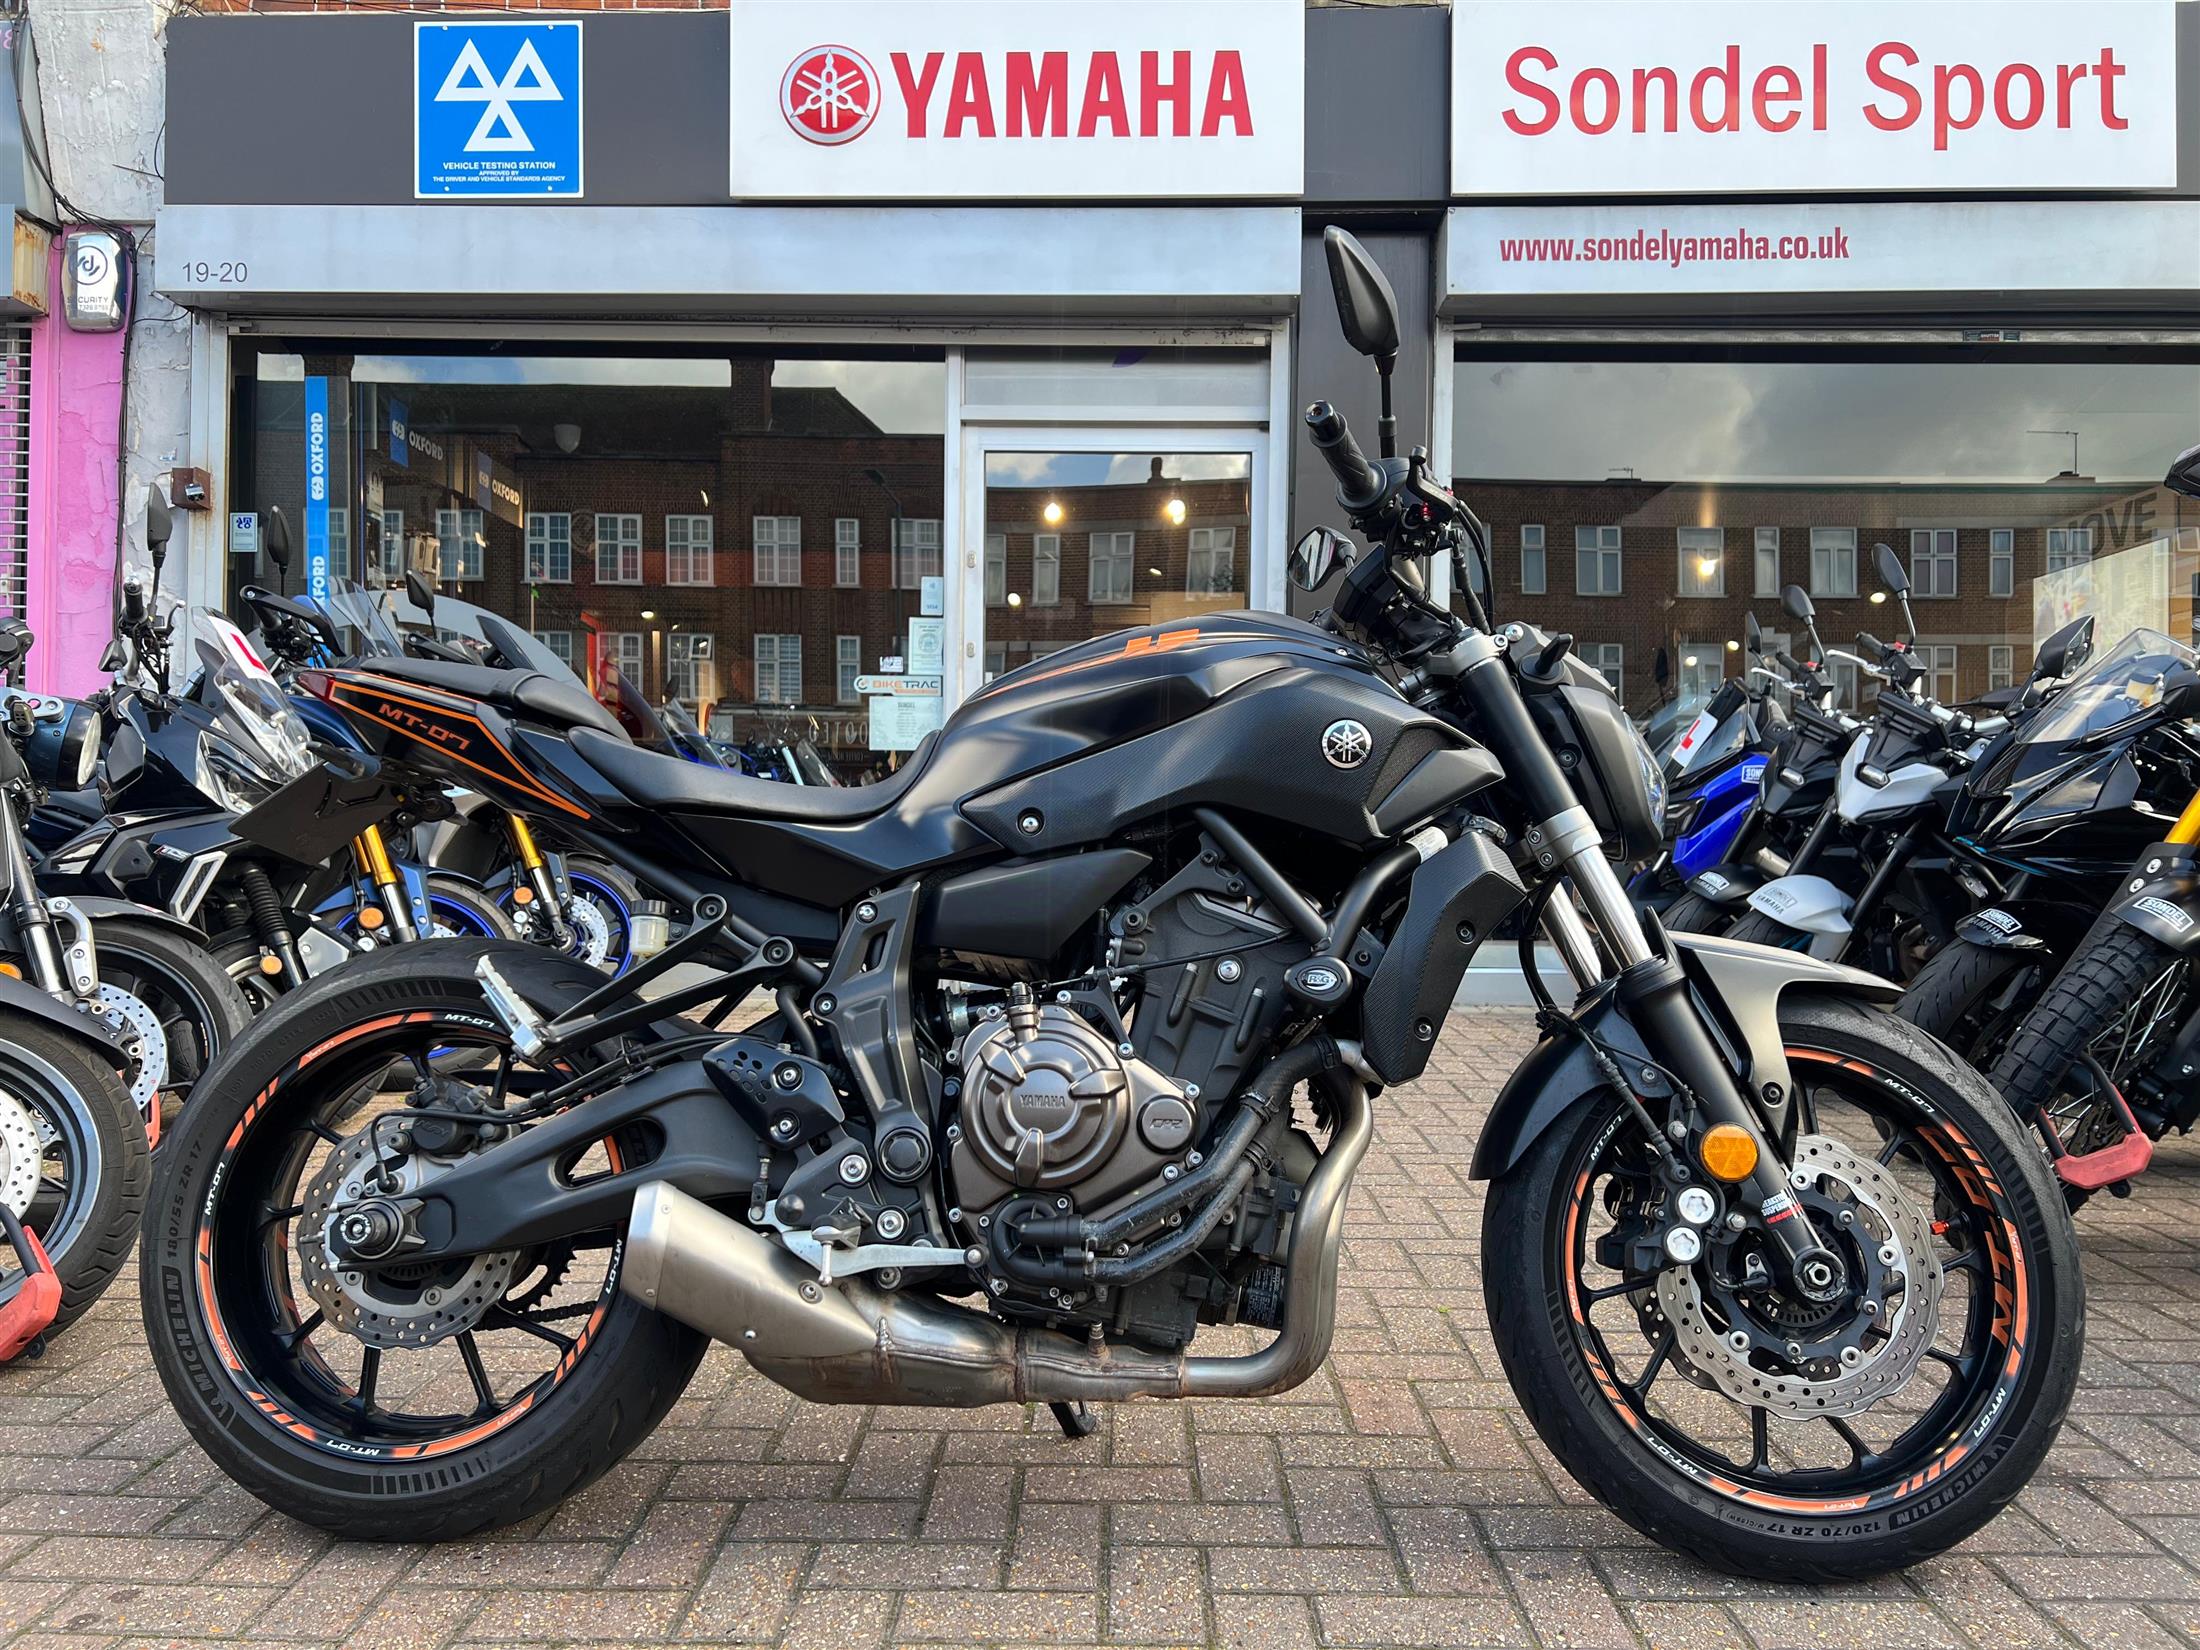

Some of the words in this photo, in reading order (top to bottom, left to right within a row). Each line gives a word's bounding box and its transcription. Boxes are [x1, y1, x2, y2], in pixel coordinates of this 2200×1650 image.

[889, 49, 1254, 139] YAMAHA
[1501, 43, 1828, 136] Sondel
[1862, 41, 2129, 152] Sport
[442, 161, 479, 170] VEHICLE
[480, 161, 517, 170] TESTING
[518, 161, 556, 170] STATION
[1499, 226, 1850, 268] www.sondelyamaha.co.uk
[182, 261, 248, 283] 19-20
[310, 411, 324, 475] OXFORD
[408, 430, 444, 462] OXFORD
[491, 479, 520, 507] OXFORD
[872, 680, 940, 690] BIKETRAC
[379, 703, 471, 751] MT-07
[1986, 909, 2017, 929] SONDEL
[2144, 898, 2188, 926] SONDEL
[444, 1012, 495, 1028] MT-07
[1020, 1094, 1066, 1109] YAMAHA
[1884, 1078, 1936, 1113] MT-07
[1590, 1114, 1622, 1161] MT-07
[166, 1194, 184, 1259] 180/55
[178, 1164, 194, 1189] ZR
[189, 1140, 201, 1160] 17
[204, 1161, 226, 1216] MT-07
[605, 1238, 623, 1295] MT-07
[165, 1274, 213, 1392] MICHELIN
[1973, 1387, 2007, 1438] MT-07
[326, 1439, 380, 1456] MT-07
[1647, 1436, 1698, 1476] MT-07
[1895, 1460, 1989, 1523] MICHELIN
[1766, 1524, 1786, 1534] 17
[1791, 1525, 1815, 1537] ZR
[1821, 1521, 1882, 1537] 120/70
